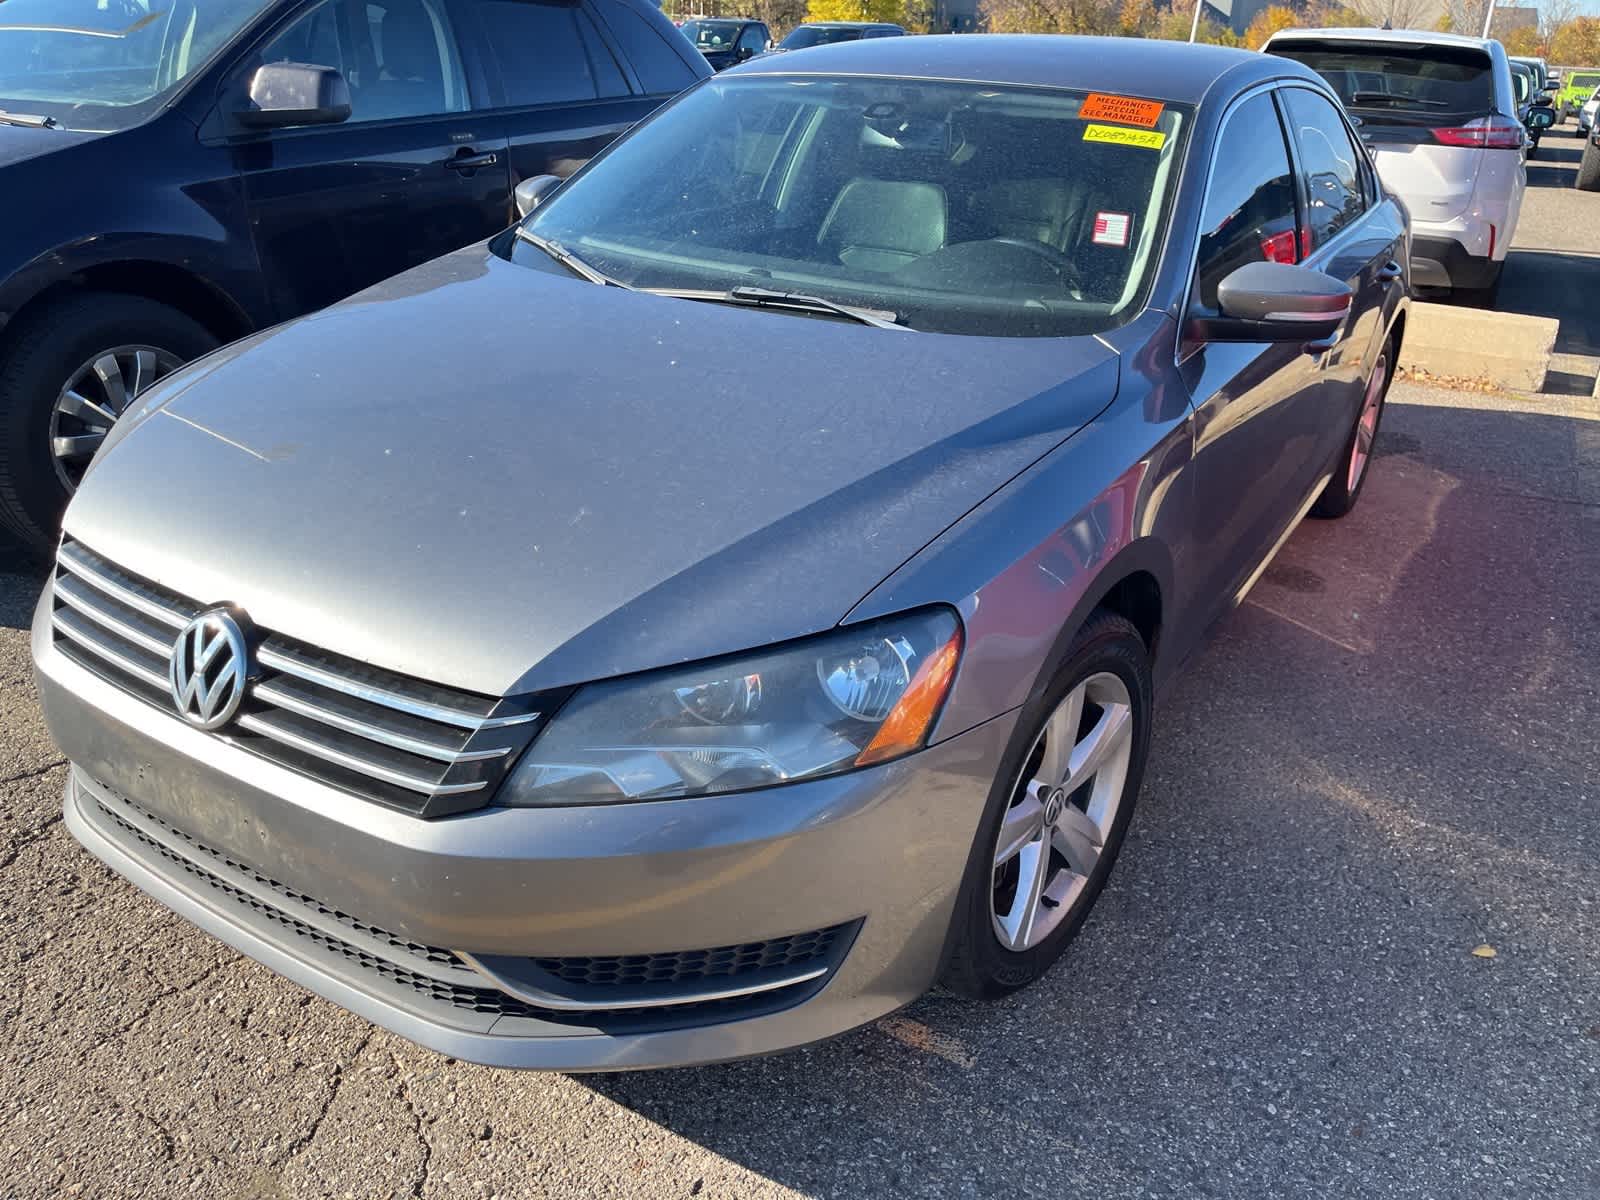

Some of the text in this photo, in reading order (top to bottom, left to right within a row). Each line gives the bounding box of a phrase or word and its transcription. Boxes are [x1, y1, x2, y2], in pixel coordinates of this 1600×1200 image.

[1096, 97, 1153, 110] MECHANICS
[1102, 105, 1141, 115] SPECIAL
[1103, 111, 1153, 124] MANAGER
